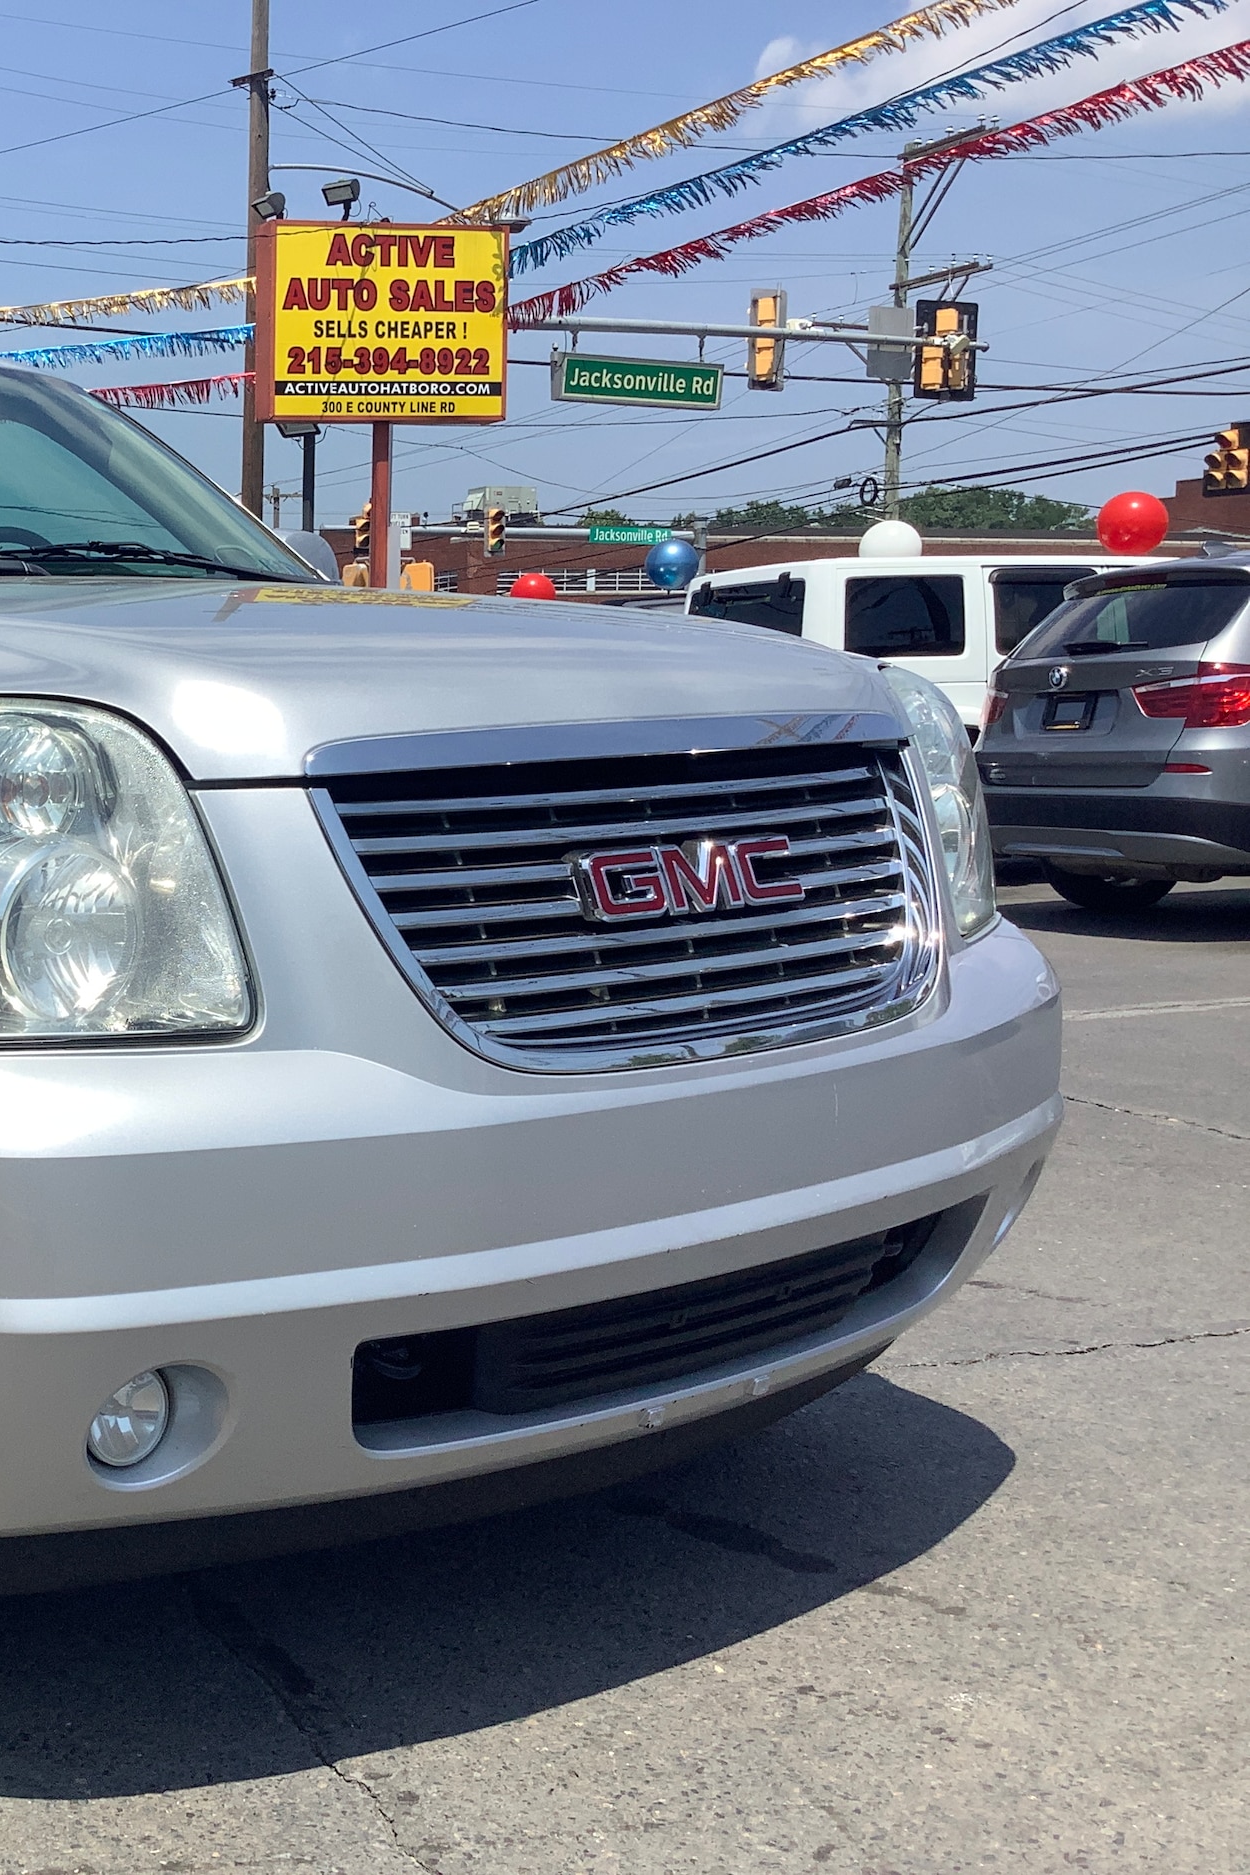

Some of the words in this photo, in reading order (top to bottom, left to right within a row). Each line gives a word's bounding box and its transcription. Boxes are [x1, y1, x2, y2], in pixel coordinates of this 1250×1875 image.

[325, 233, 455, 268] ACTIVE
[282, 277, 378, 311] AUTO
[389, 279, 496, 313] SALES
[313, 320, 368, 339] SELLS
[375, 321, 456, 339] CHEAPER
[287, 346, 490, 375] 215-394-8922
[284, 382, 490, 395] ACTIVEAUTOHATBORO.COM
[569, 368, 686, 394] Jacksonville
[691, 376, 714, 396] Rd
[321, 402, 343, 413] 300
[346, 402, 353, 413] E
[357, 402, 405, 413] COUNTY
[410, 402, 435, 413] LINE
[440, 402, 456, 413] RD
[594, 529, 653, 542] Jacksonville
[655, 530, 668, 542] Rd
[1135, 666, 1174, 678] X3
[584, 836, 805, 923] GMC
